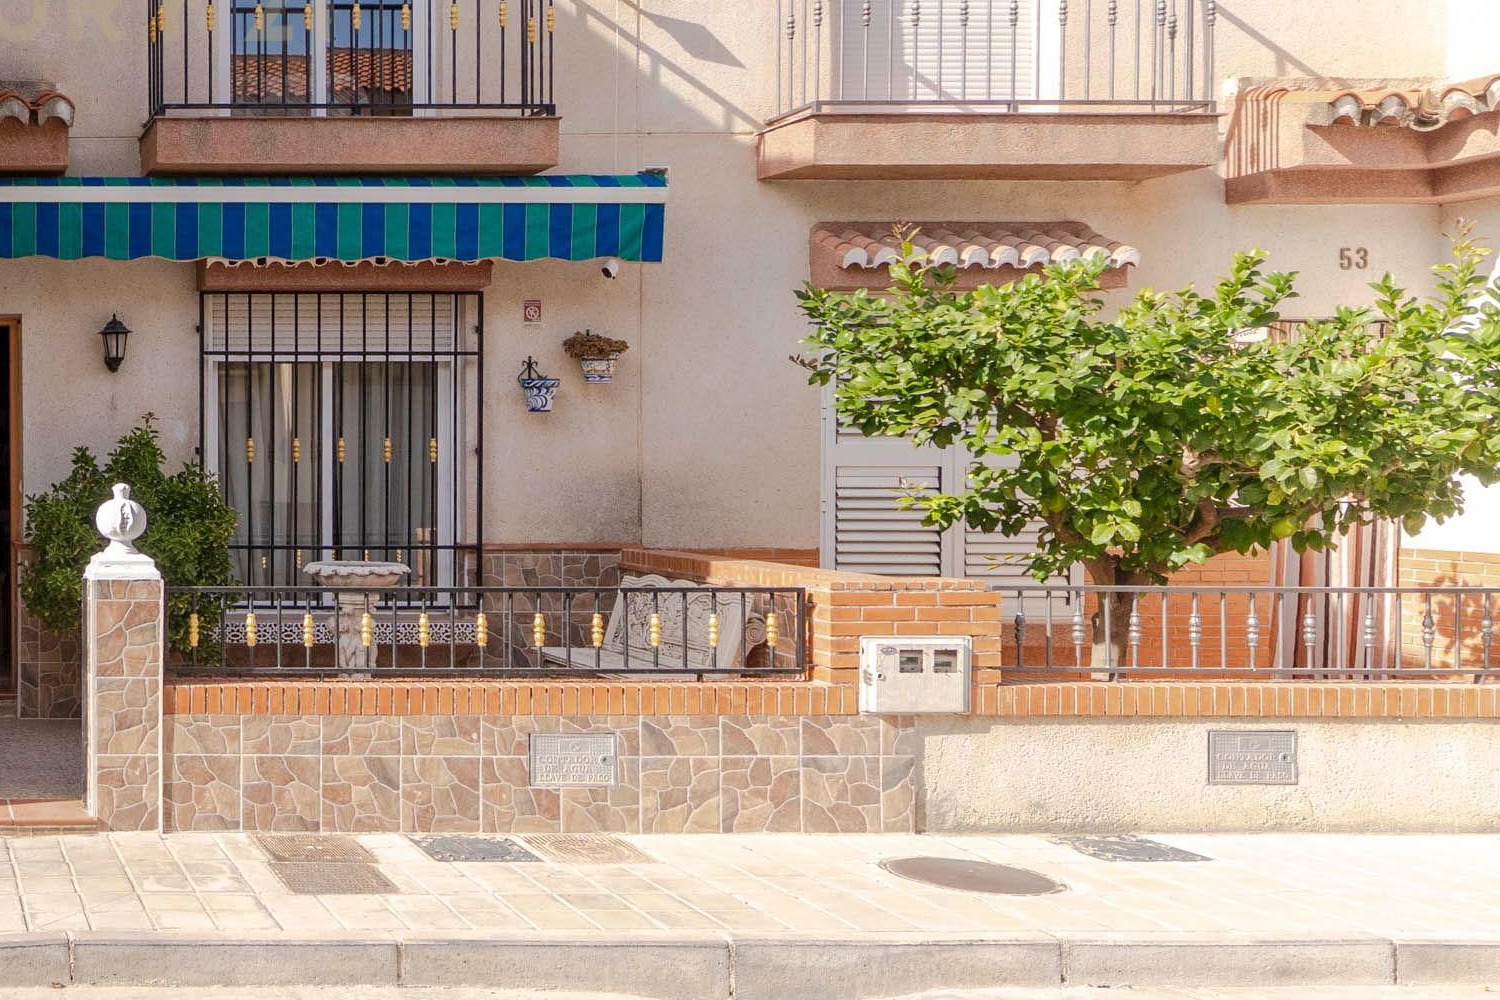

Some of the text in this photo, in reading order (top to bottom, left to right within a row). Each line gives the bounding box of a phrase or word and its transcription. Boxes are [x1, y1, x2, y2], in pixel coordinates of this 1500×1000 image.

[1339, 247, 1368, 270] 53
[539, 755, 598, 763] CONTADOR
[543, 765, 593, 773] DE AGUA
[539, 774, 610, 782] LLAVE DE PASO
